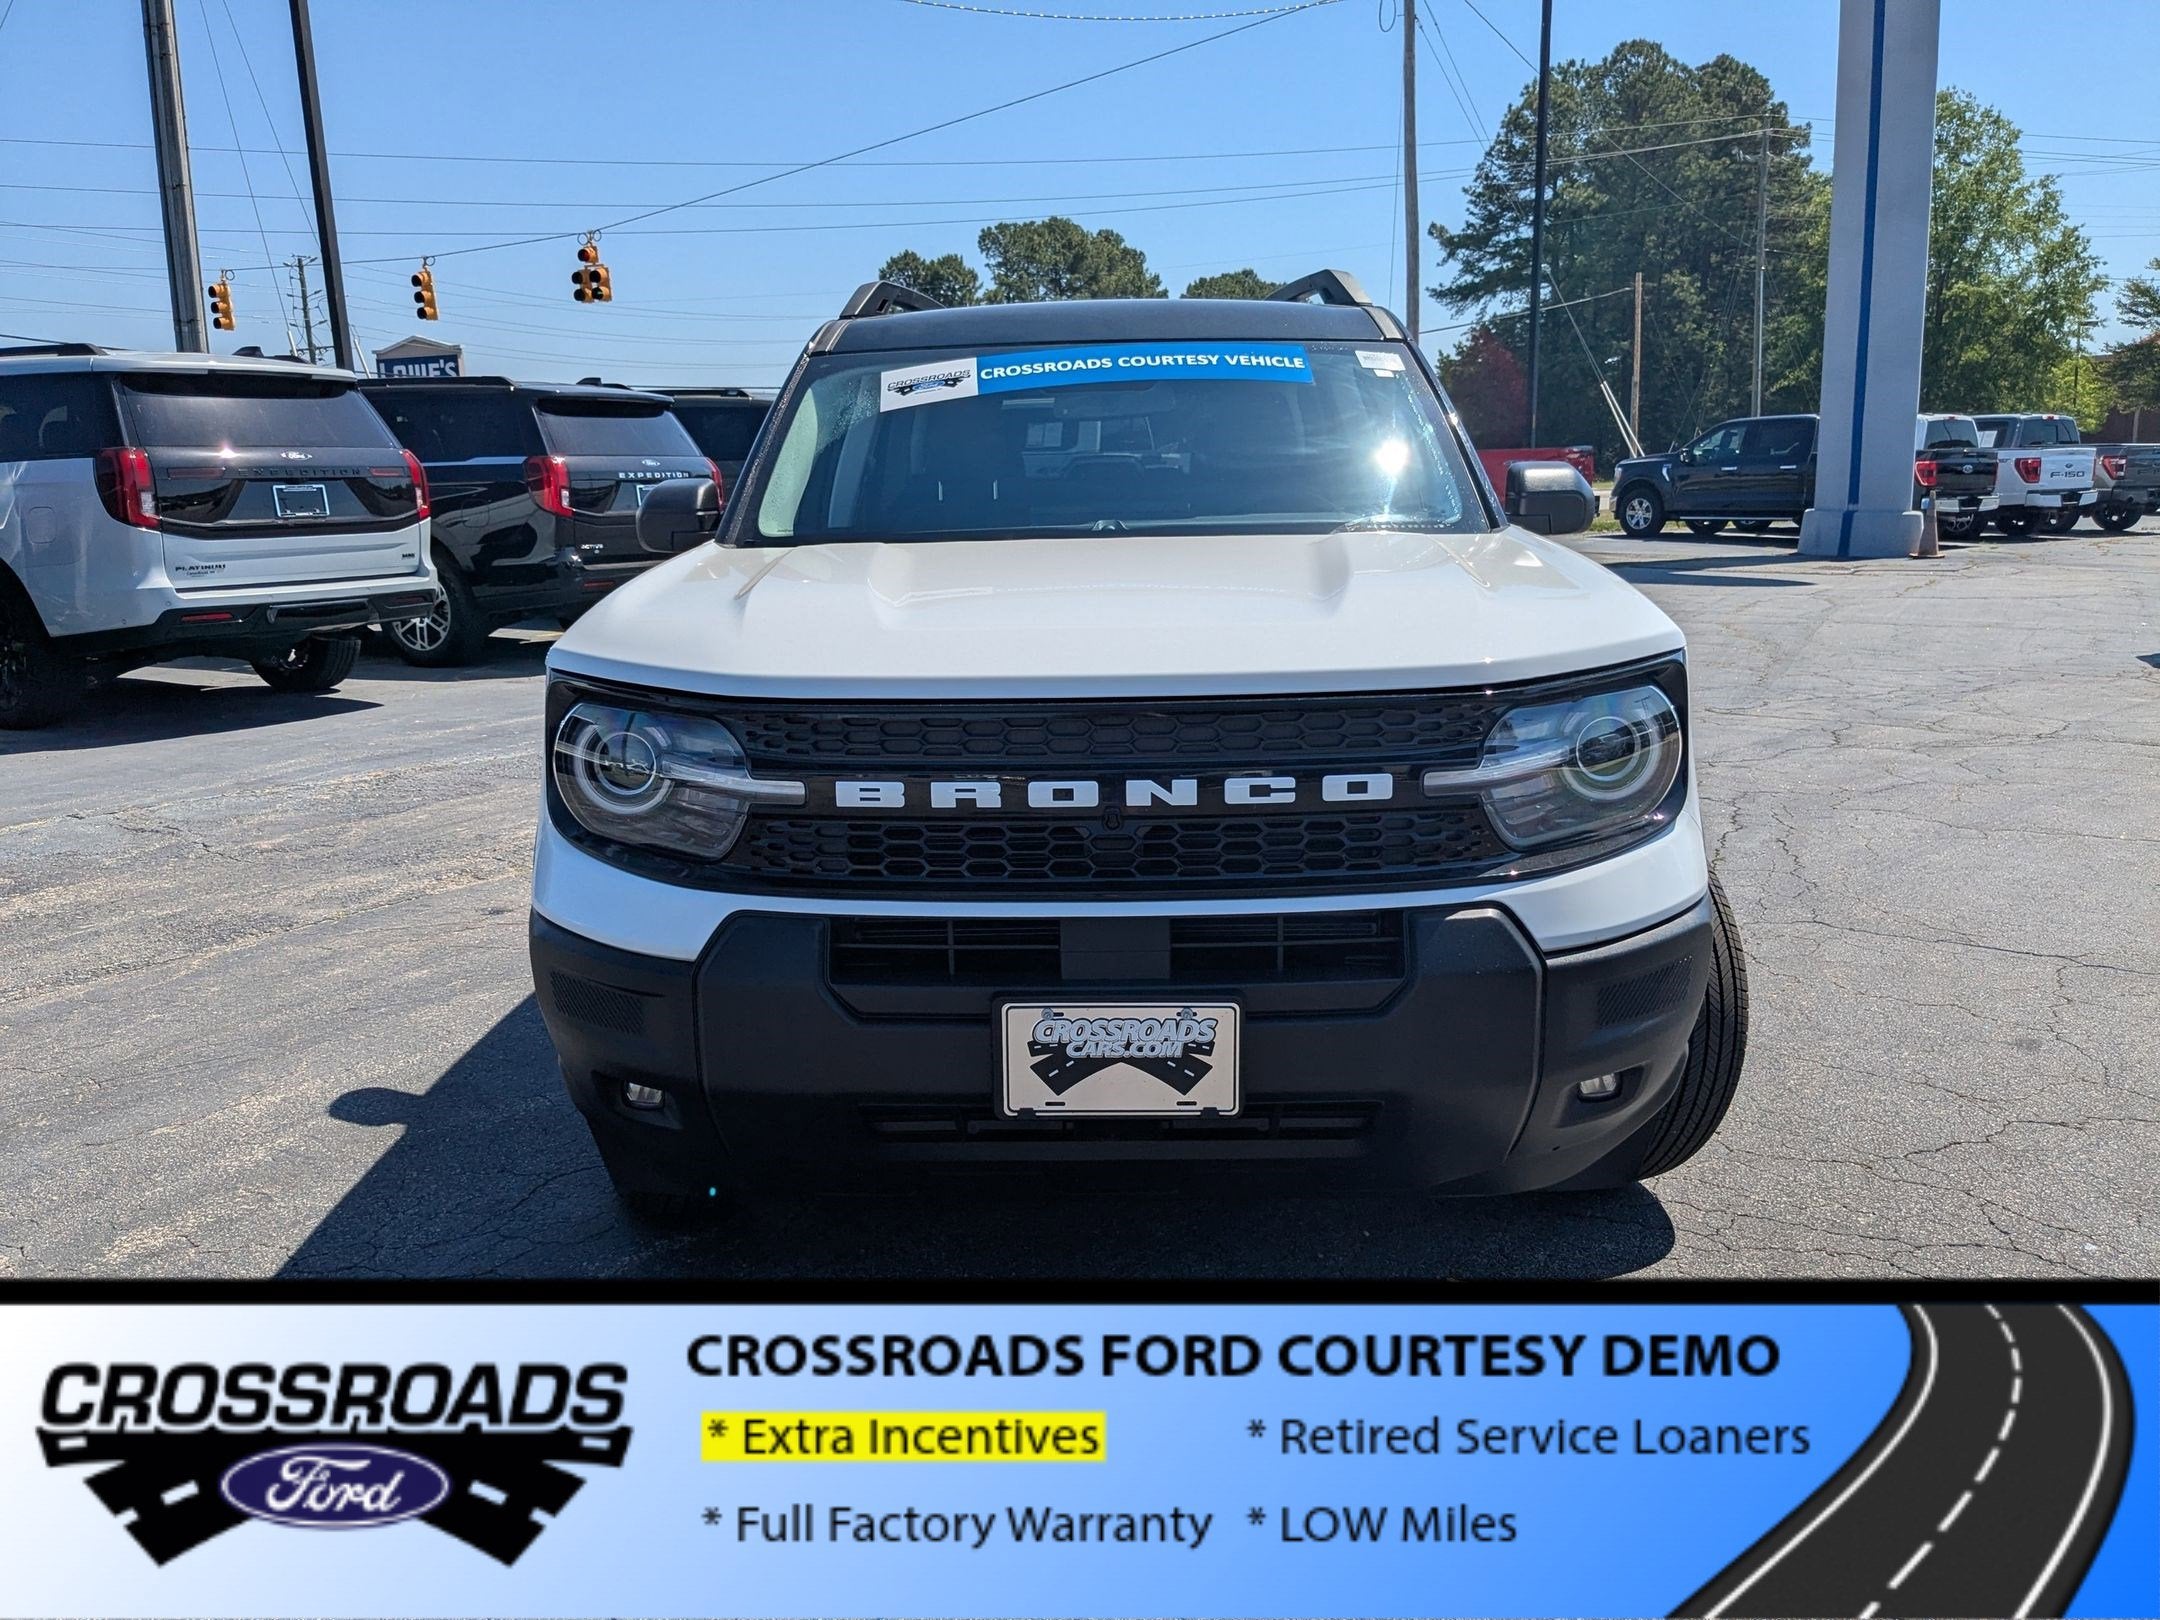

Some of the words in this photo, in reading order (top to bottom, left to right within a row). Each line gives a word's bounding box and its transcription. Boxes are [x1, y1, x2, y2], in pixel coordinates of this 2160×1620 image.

[980, 357, 1113, 380] CROSSROADS
[1117, 354, 1219, 368] COURTESY
[1225, 354, 1306, 369] VEHICLE
[887, 369, 971, 390] CROSSROADS
[238, 467, 360, 476] EXPEDITION
[2050, 470, 2086, 478] F-150
[175, 563, 226, 572] PLATINUM
[835, 773, 1394, 808] BRONCO
[1031, 1017, 1219, 1045] CROSSROADS
[1065, 1040, 1186, 1059] CARS.COM
